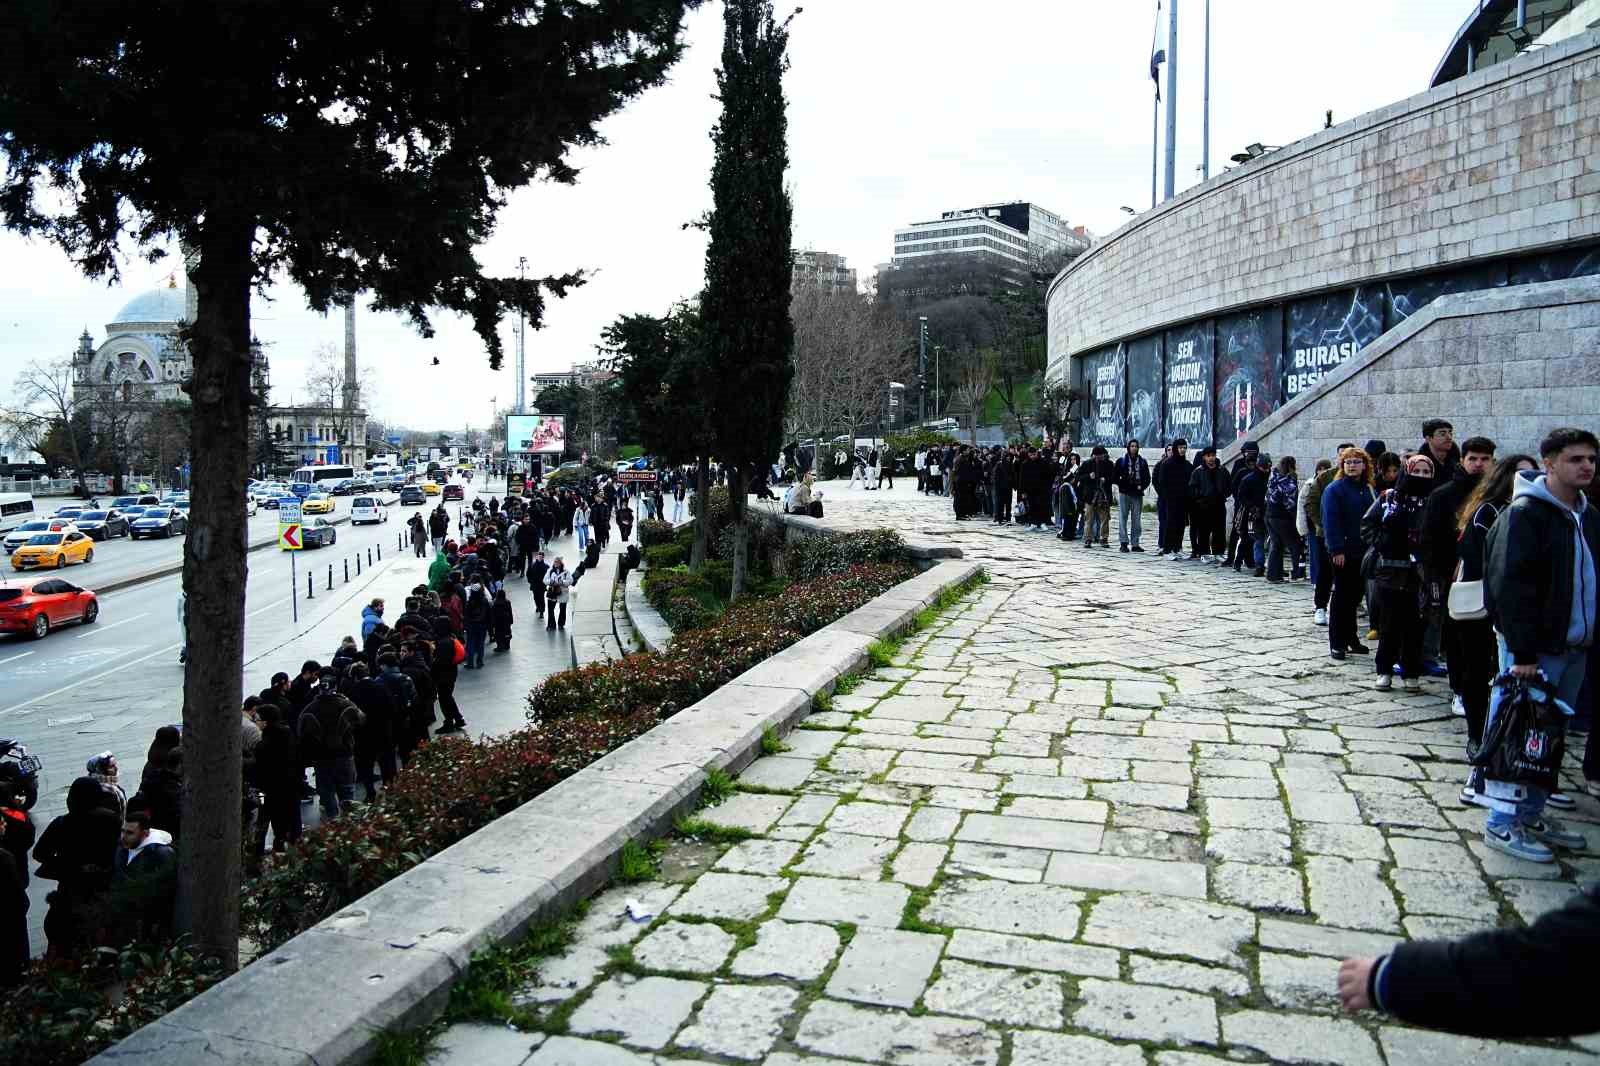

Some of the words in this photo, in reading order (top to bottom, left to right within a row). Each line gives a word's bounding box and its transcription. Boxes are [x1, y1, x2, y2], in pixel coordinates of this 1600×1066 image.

[1176, 340, 1194, 359] SEN
[1295, 342, 1356, 368] BURASI
[1171, 361, 1201, 382] VARDIN
[1171, 407, 1202, 425] YOKKEN
